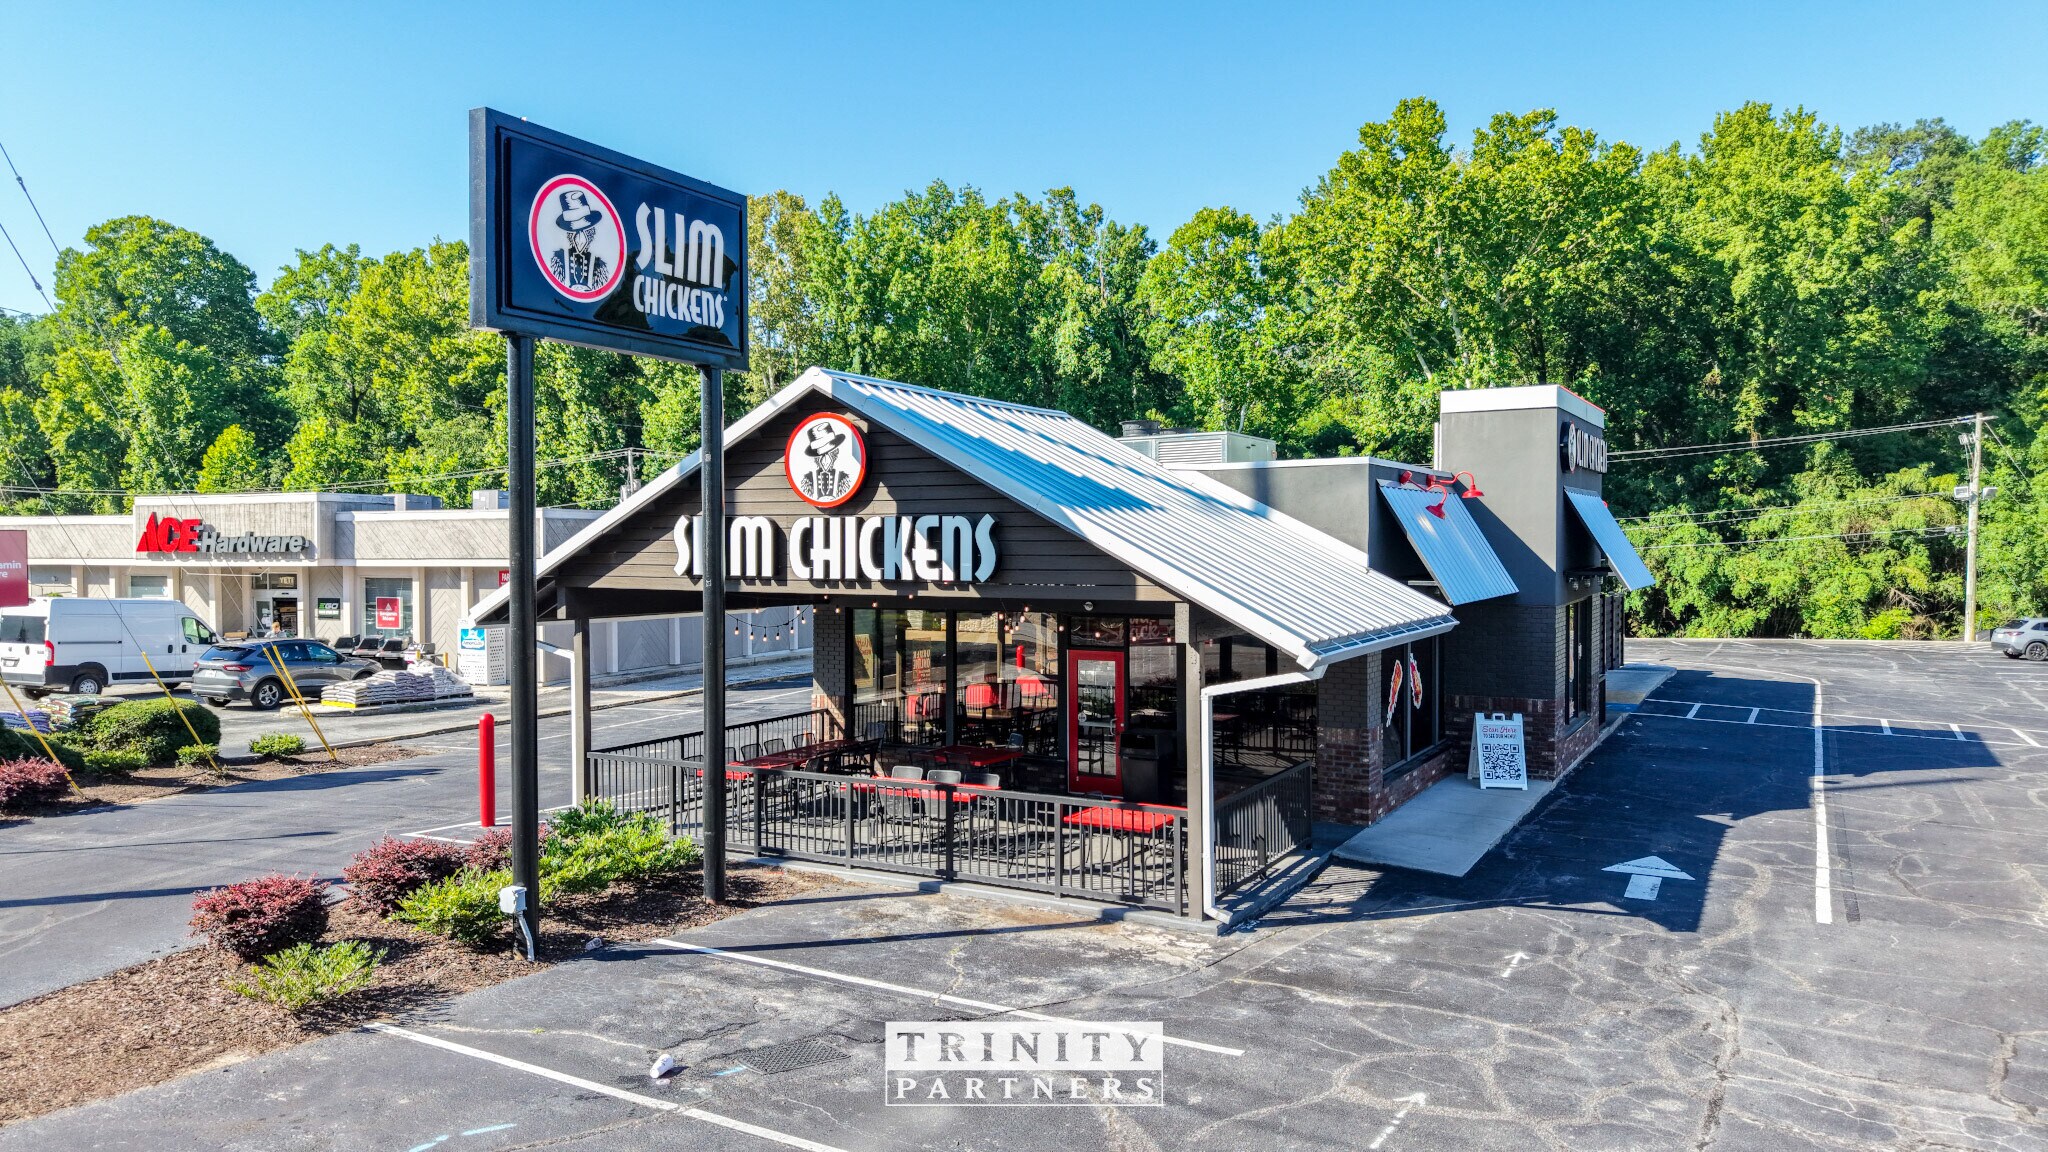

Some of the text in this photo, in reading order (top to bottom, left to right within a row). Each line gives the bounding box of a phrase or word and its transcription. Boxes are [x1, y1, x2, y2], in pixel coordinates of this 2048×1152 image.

[635, 201, 725, 289] SLIM
[633, 274, 725, 329] CHICKENS
[136, 511, 304, 553] ACE Hardware
[789, 513, 997, 584] CHICKENS
